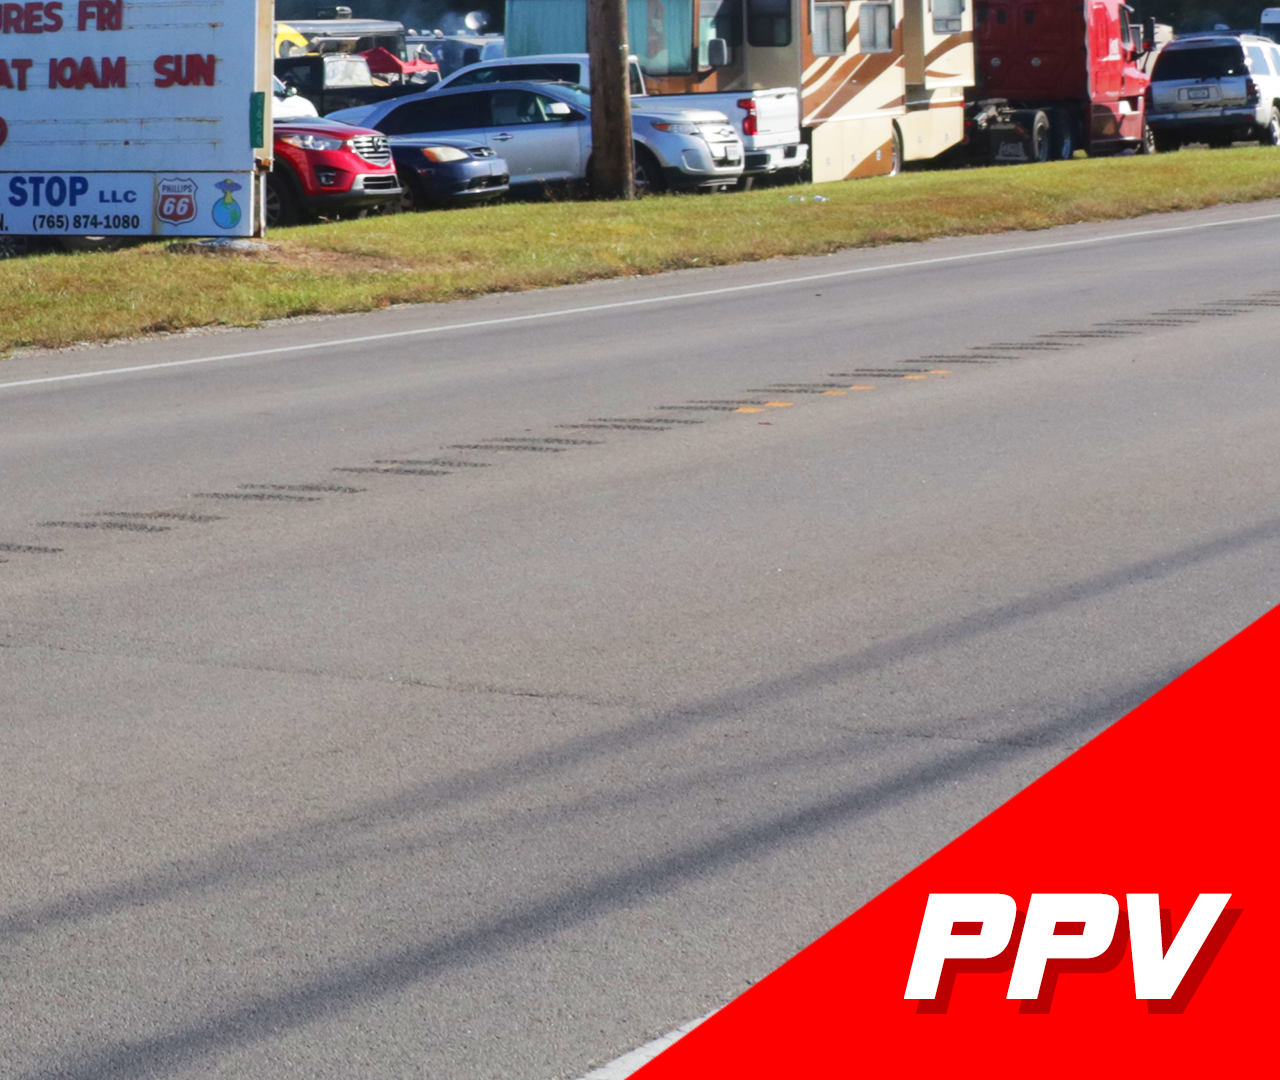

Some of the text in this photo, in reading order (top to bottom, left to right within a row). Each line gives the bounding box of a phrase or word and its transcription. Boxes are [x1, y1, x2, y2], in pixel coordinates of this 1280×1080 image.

[77, 0, 124, 31] FRI
[49, 56, 127, 90] 10AM
[153, 54, 216, 88] SUN
[8, 175, 89, 207] STOP
[99, 190, 138, 203] LLC
[162, 184, 193, 193] PHILLIPS
[163, 197, 190, 215] 66
[33, 213, 140, 231] (765) 874-1080
